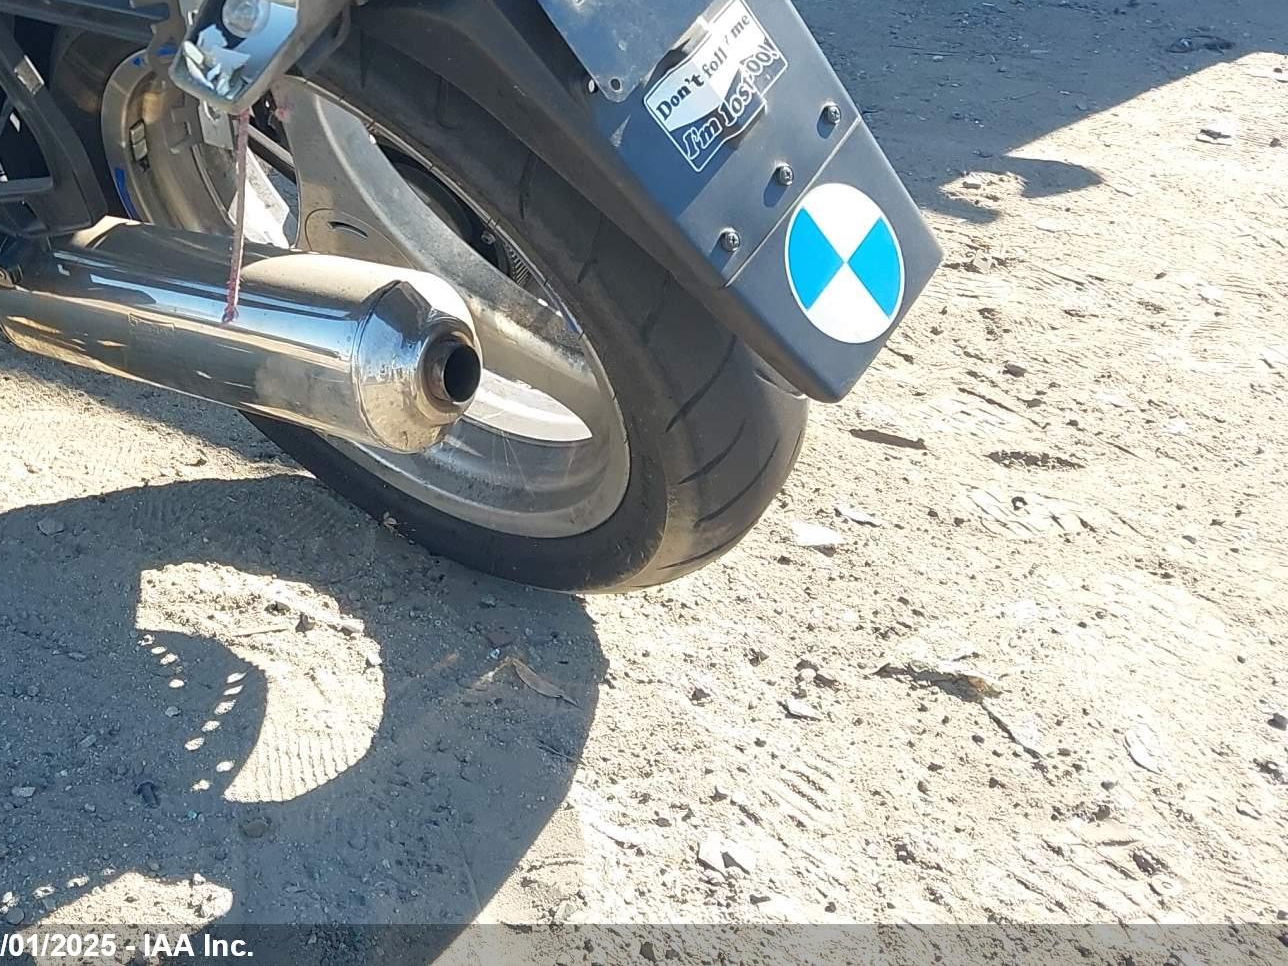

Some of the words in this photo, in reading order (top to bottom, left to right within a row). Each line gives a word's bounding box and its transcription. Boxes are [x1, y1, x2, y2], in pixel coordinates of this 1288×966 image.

[656, 74, 705, 122] Don't
[700, 36, 732, 79] foll
[730, 13, 751, 42] me
[682, 115, 722, 160] I'm
[744, 38, 780, 81] oo!
